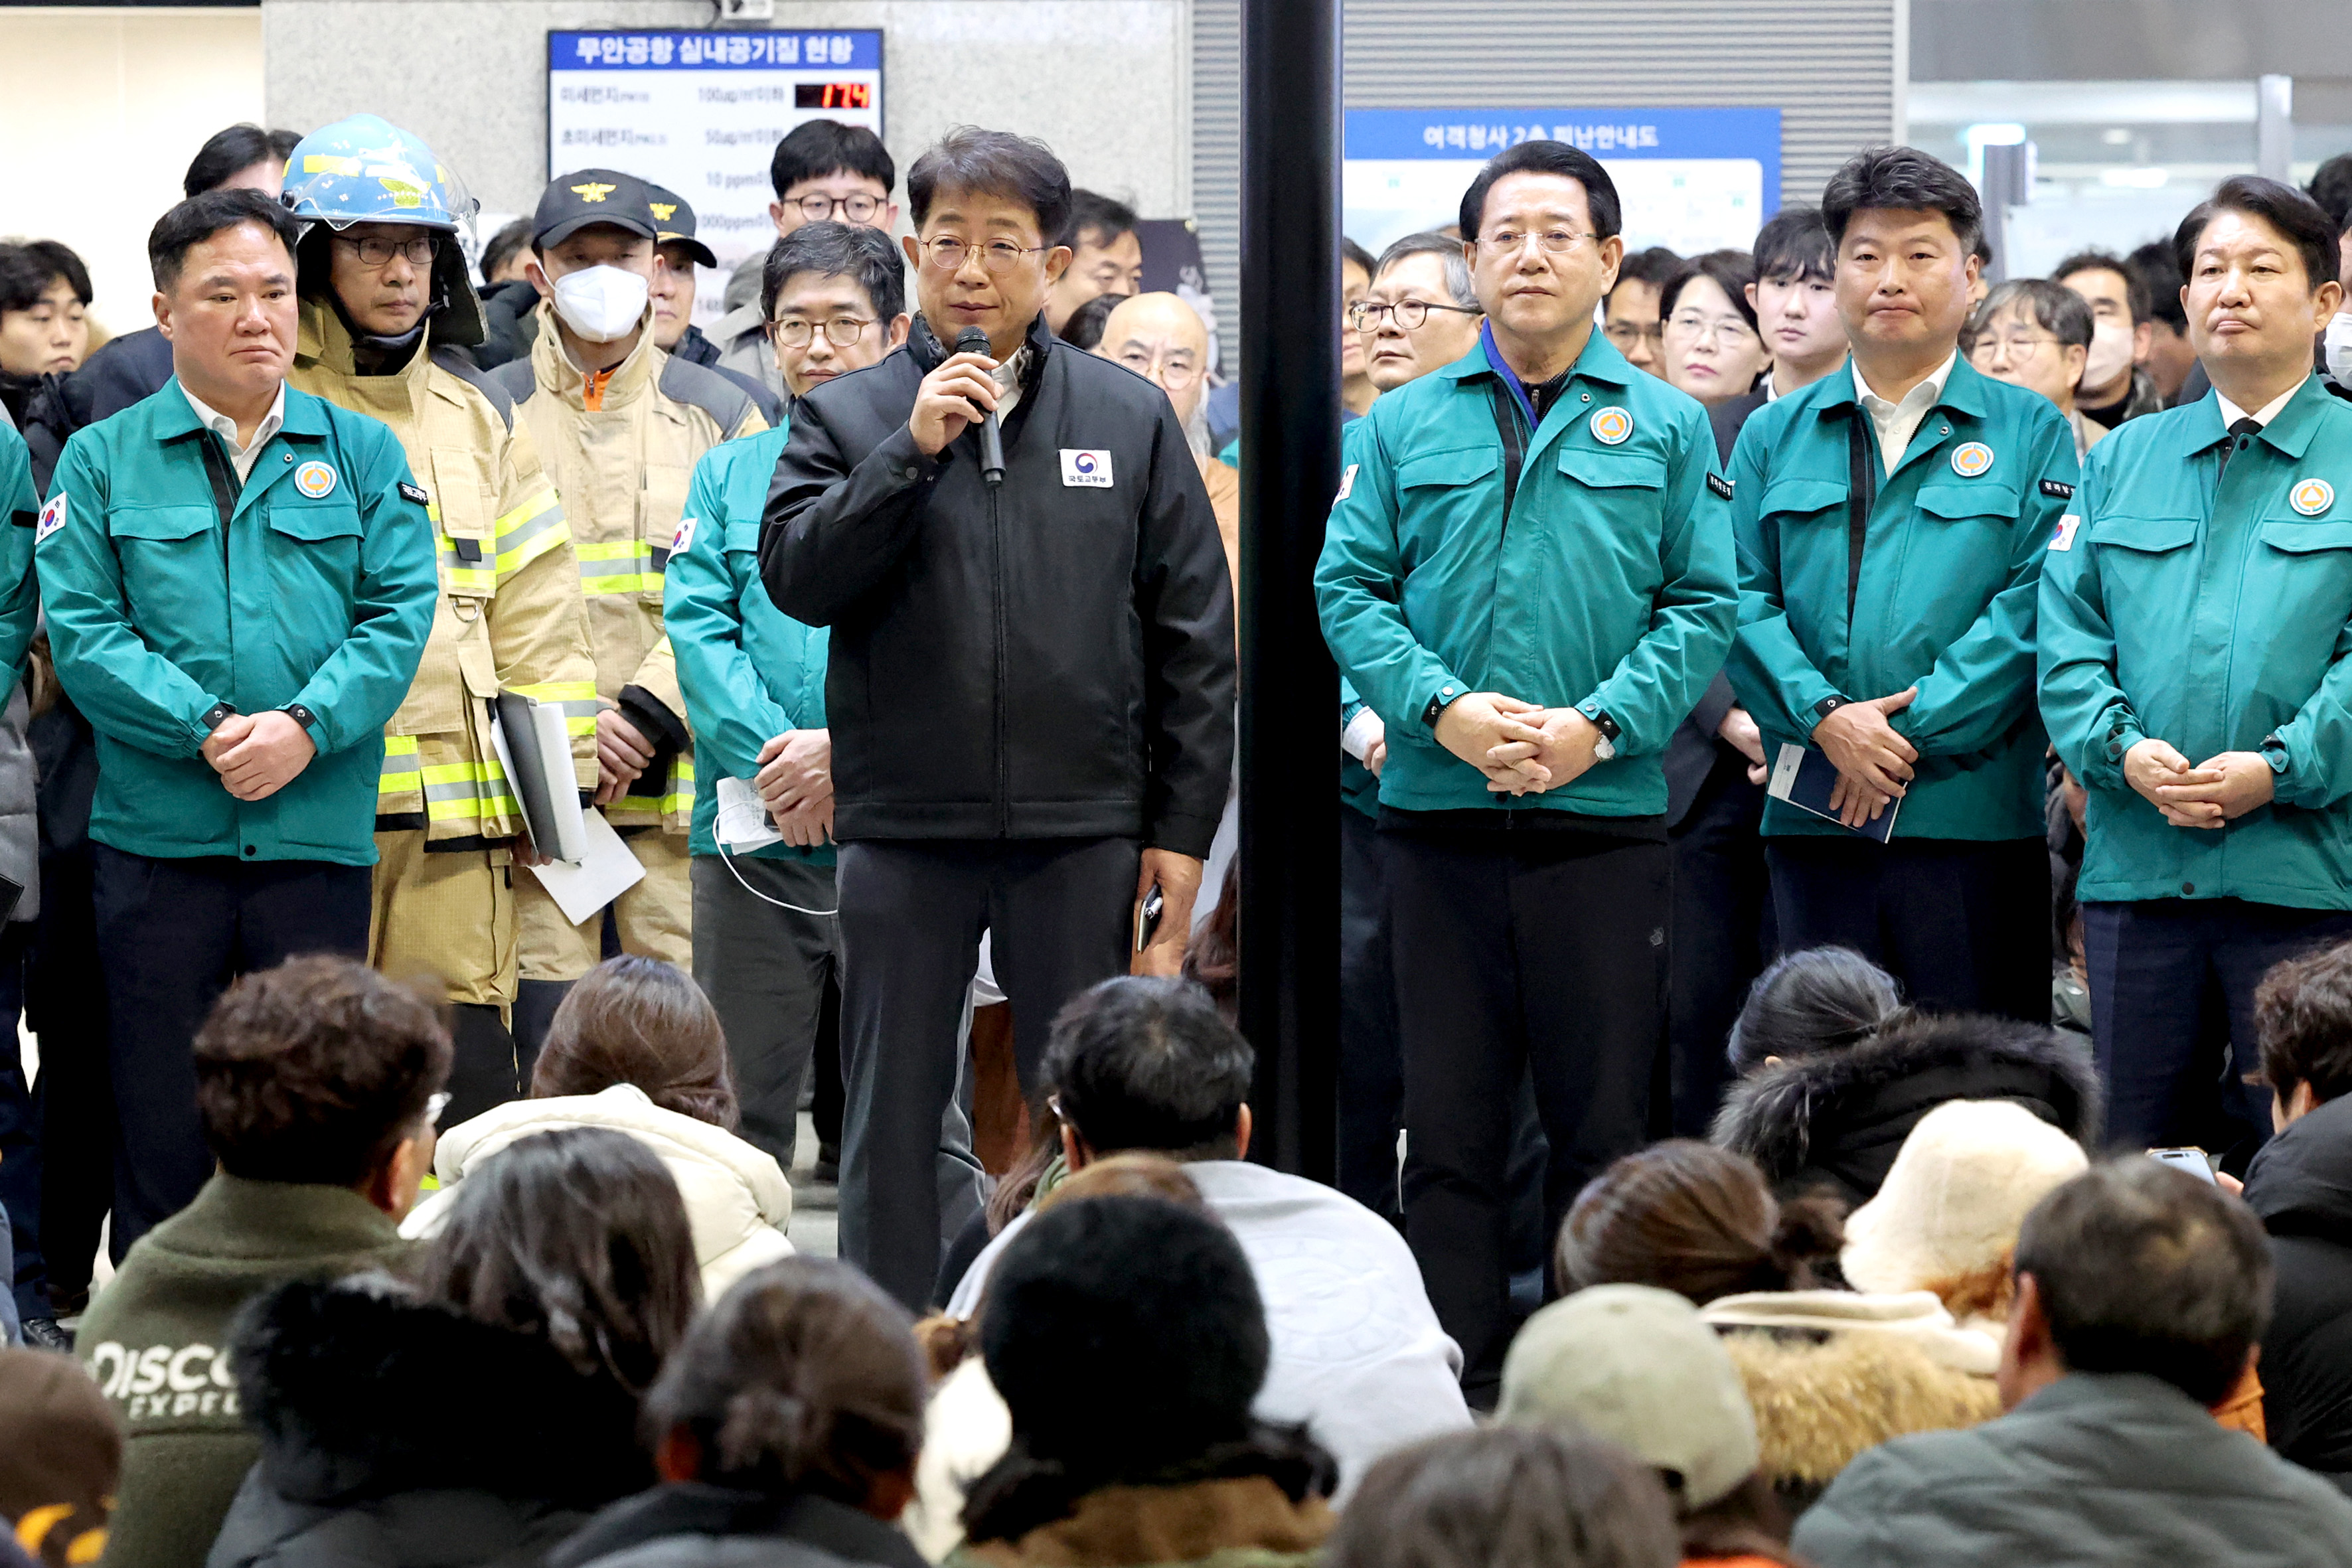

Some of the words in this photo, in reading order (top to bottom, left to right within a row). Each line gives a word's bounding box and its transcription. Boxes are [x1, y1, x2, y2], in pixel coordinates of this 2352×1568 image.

[576, 37, 674, 64] 무안공항
[678, 37, 799, 64] 실내공기질
[805, 37, 854, 64] 현황
